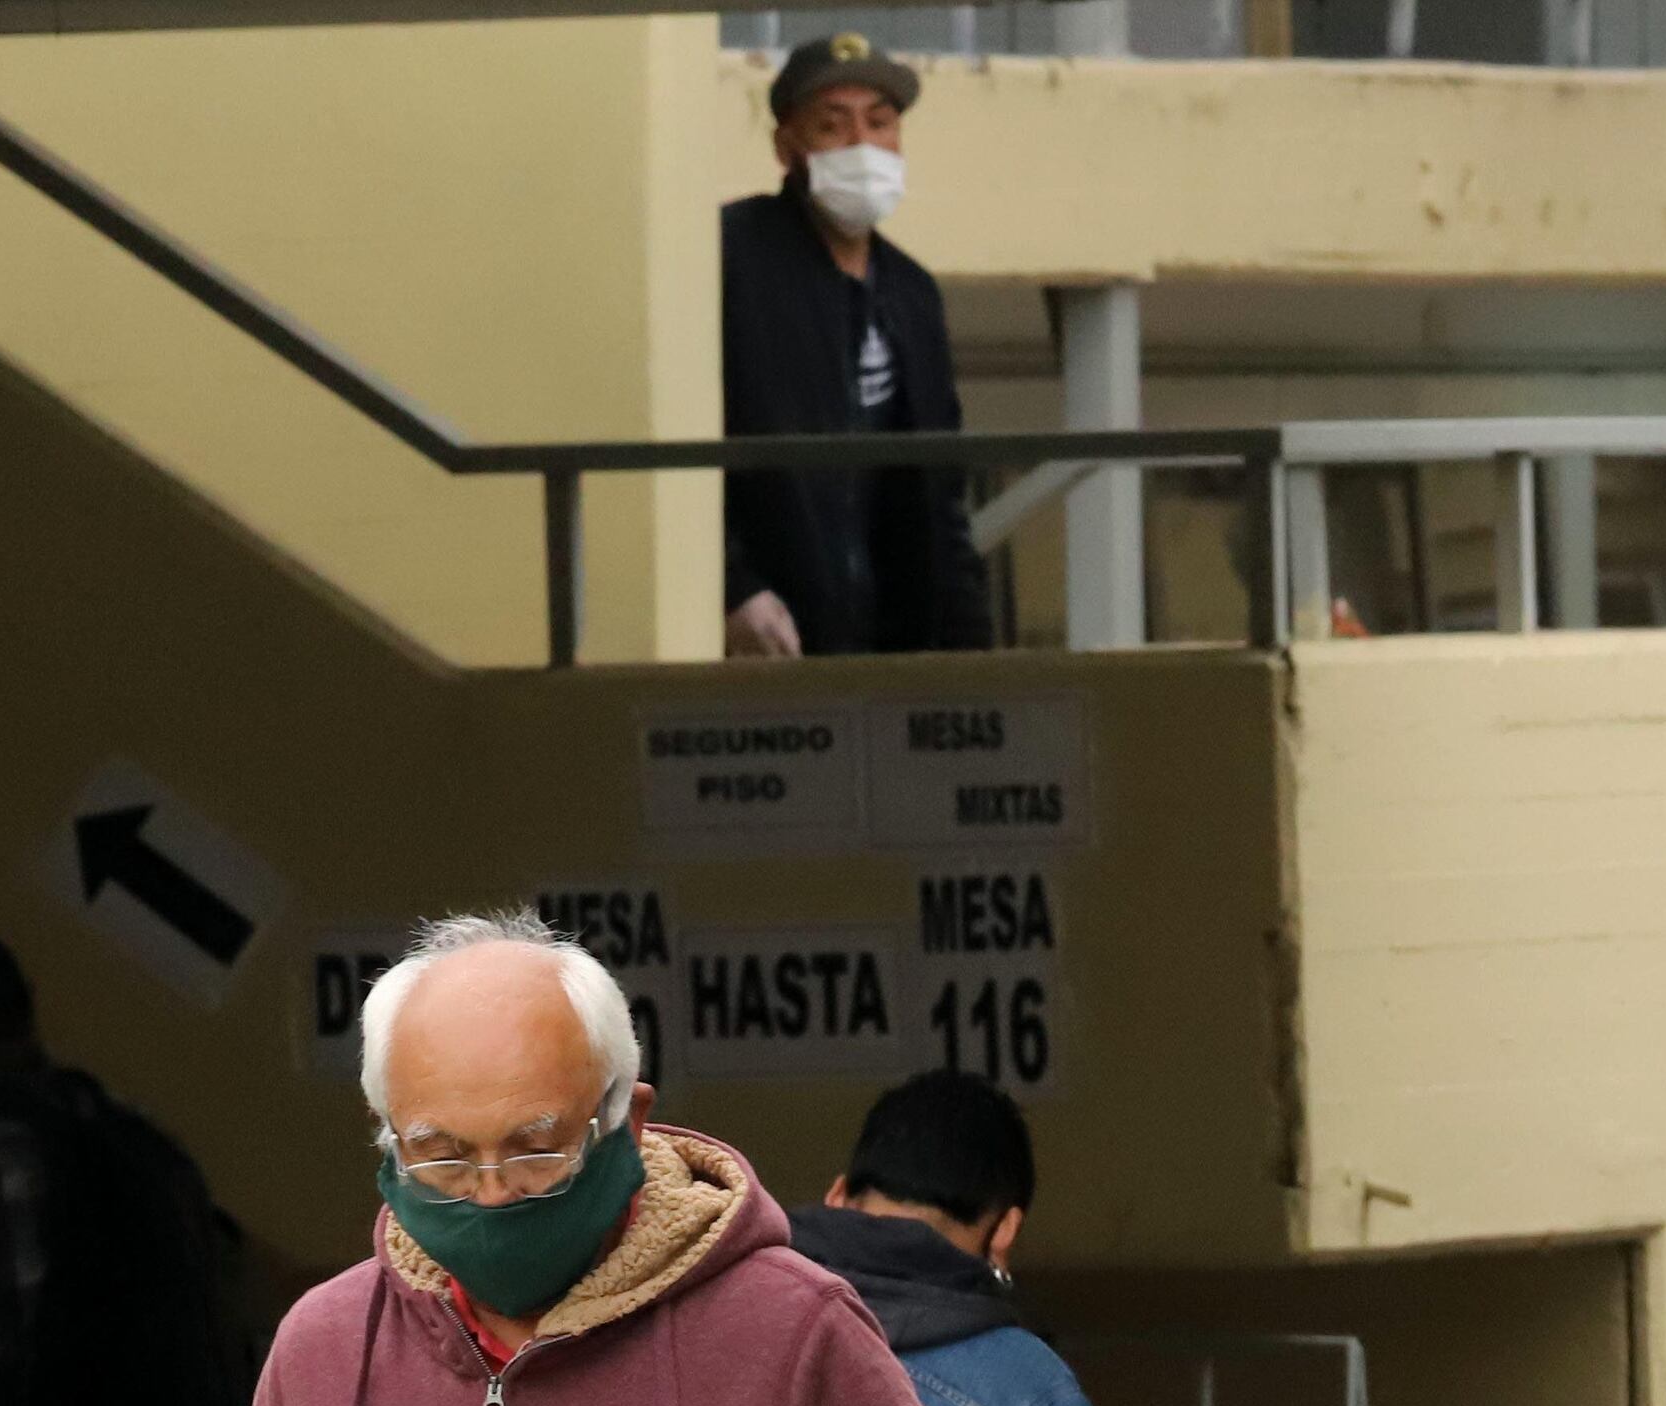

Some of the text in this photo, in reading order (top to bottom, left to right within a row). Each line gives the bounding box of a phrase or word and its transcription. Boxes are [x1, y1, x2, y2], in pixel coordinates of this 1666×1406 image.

[648, 724, 835, 758] SEGUNDO
[907, 709, 1005, 752] MESAS
[696, 772, 787, 803] PISO
[955, 783, 1064, 826] MIXTAS
[919, 873, 1056, 953] MESA
[691, 952, 890, 1039] HASTA
[929, 977, 1048, 1082] 116
